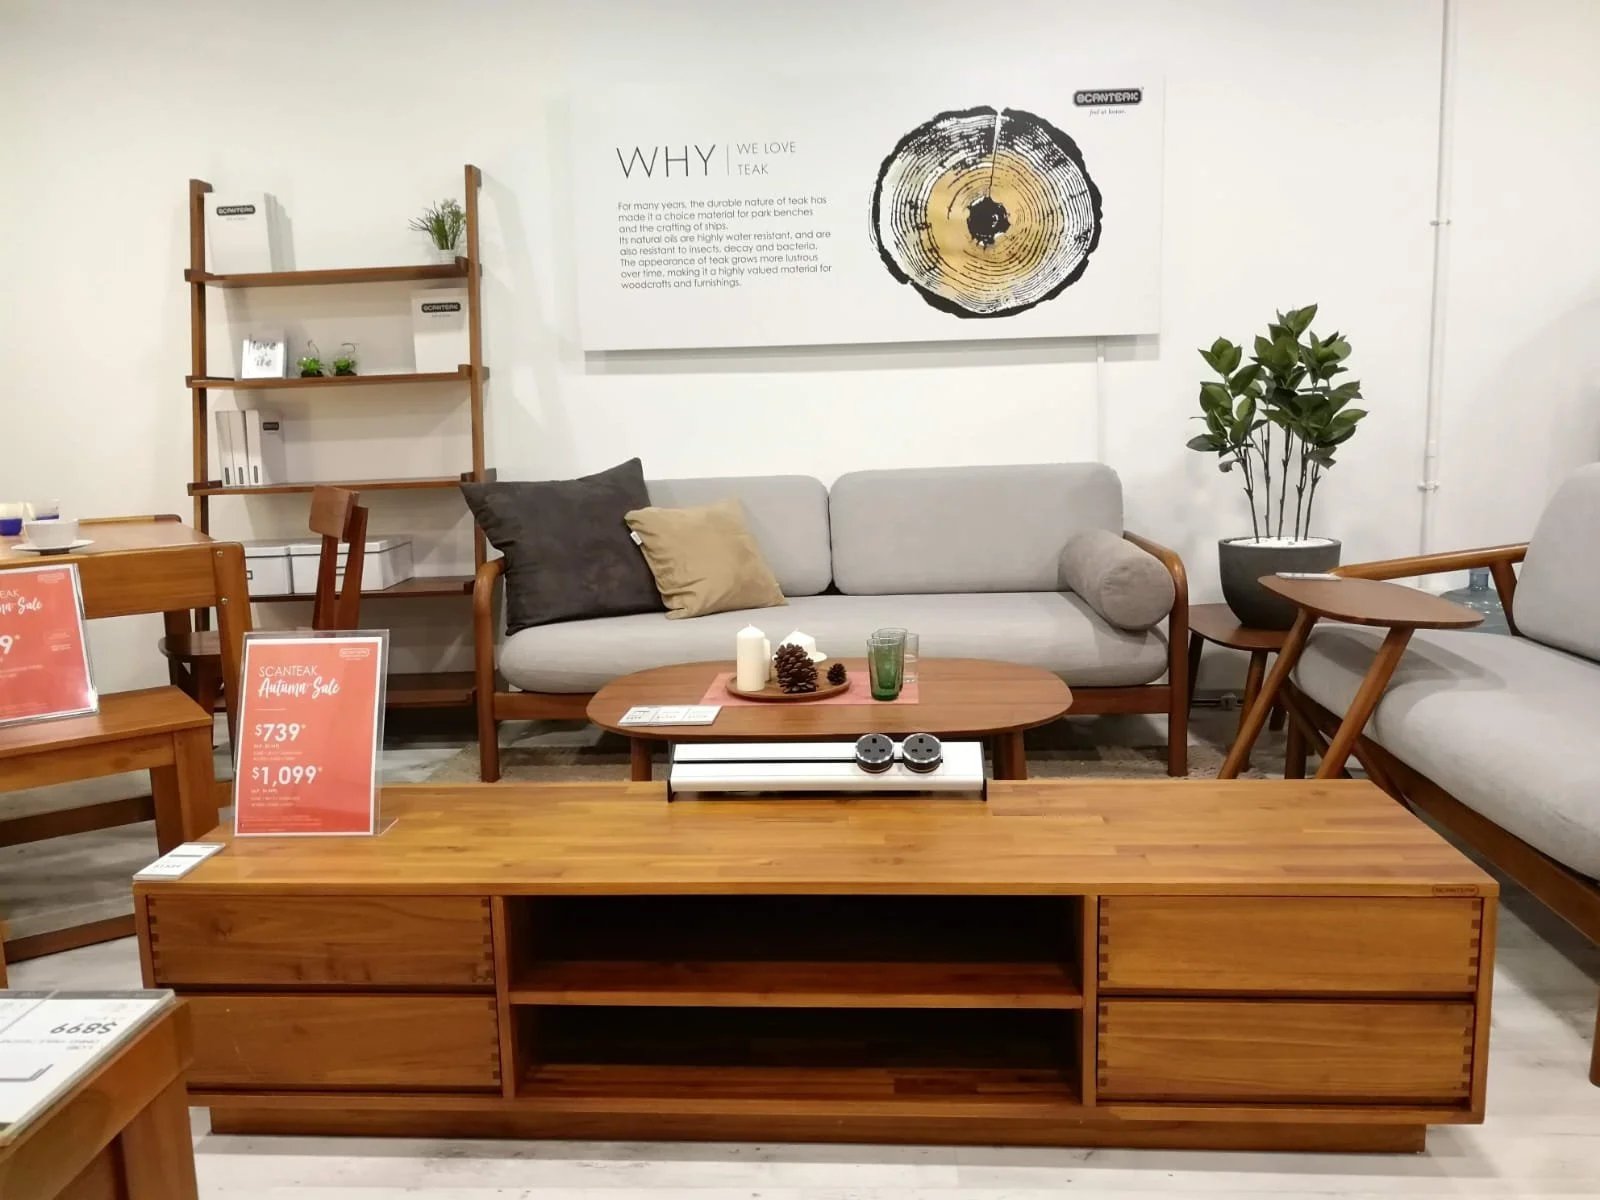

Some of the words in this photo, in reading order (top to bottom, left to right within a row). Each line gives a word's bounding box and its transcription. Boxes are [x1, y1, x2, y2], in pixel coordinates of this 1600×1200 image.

[737, 142, 758, 154] WE
[764, 141, 796, 154] LOVE
[616, 144, 716, 178] WHY
[738, 164, 768, 176] TEAK
[618, 201, 631, 210] For
[634, 202, 659, 210] many
[661, 201, 687, 210] years,
[690, 200, 705, 208] the
[707, 199, 742, 208] durable
[744, 198, 774, 206] nature
[776, 197, 786, 205] of
[788, 196, 808, 205] teak
[810, 196, 827, 204] has
[618, 213, 646, 222] made
[647, 213, 653, 221] it
[664, 212, 695, 221] choice
[697, 210, 735, 219] material
[737, 210, 749, 218] for
[751, 209, 772, 219] park
[773, 208, 813, 217] benches
[618, 224, 637, 233] and
[639, 224, 654, 232] the
[656, 223, 691, 232] crafting
[693, 222, 703, 231] of
[704, 222, 728, 231] ships.
[619, 236, 628, 245] Its
[630, 235, 662, 244] natural
[664, 234, 678, 243] oils
[697, 233, 723, 243] highly
[753, 232, 793, 241] resistant,
[794, 231, 813, 239] and
[619, 247, 638, 256] also
[639, 246, 675, 255] resistant
[678, 246, 687, 254] to
[689, 246, 721, 254] insects,
[724, 244, 753, 253] decay
[755, 243, 774, 251] and
[776, 242, 818, 251] bacteria,
[620, 258, 636, 267] The
[638, 258, 695, 267] appearance
[697, 256, 706, 265] of
[709, 255, 729, 264] teak
[731, 256, 757, 265] grows
[785, 254, 818, 262] lustrous
[620, 270, 640, 278] over
[643, 269, 665, 278] time,
[667, 268, 700, 277] making
[702, 268, 708, 276] it
[718, 266, 745, 277] highly
[747, 266, 778, 274] valued
[780, 265, 817, 273] material
[819, 264, 832, 272] for
[621, 280, 672, 289] woodcrafts
[674, 279, 691, 287] and
[694, 278, 742, 288] furnishings.
[17, 596, 43, 615] Sale
[258, 665, 318, 678] SCANTEAK
[258, 678, 306, 699] Autumn
[312, 676, 340, 699] Sale
[50, 1022, 118, 1035] $899
